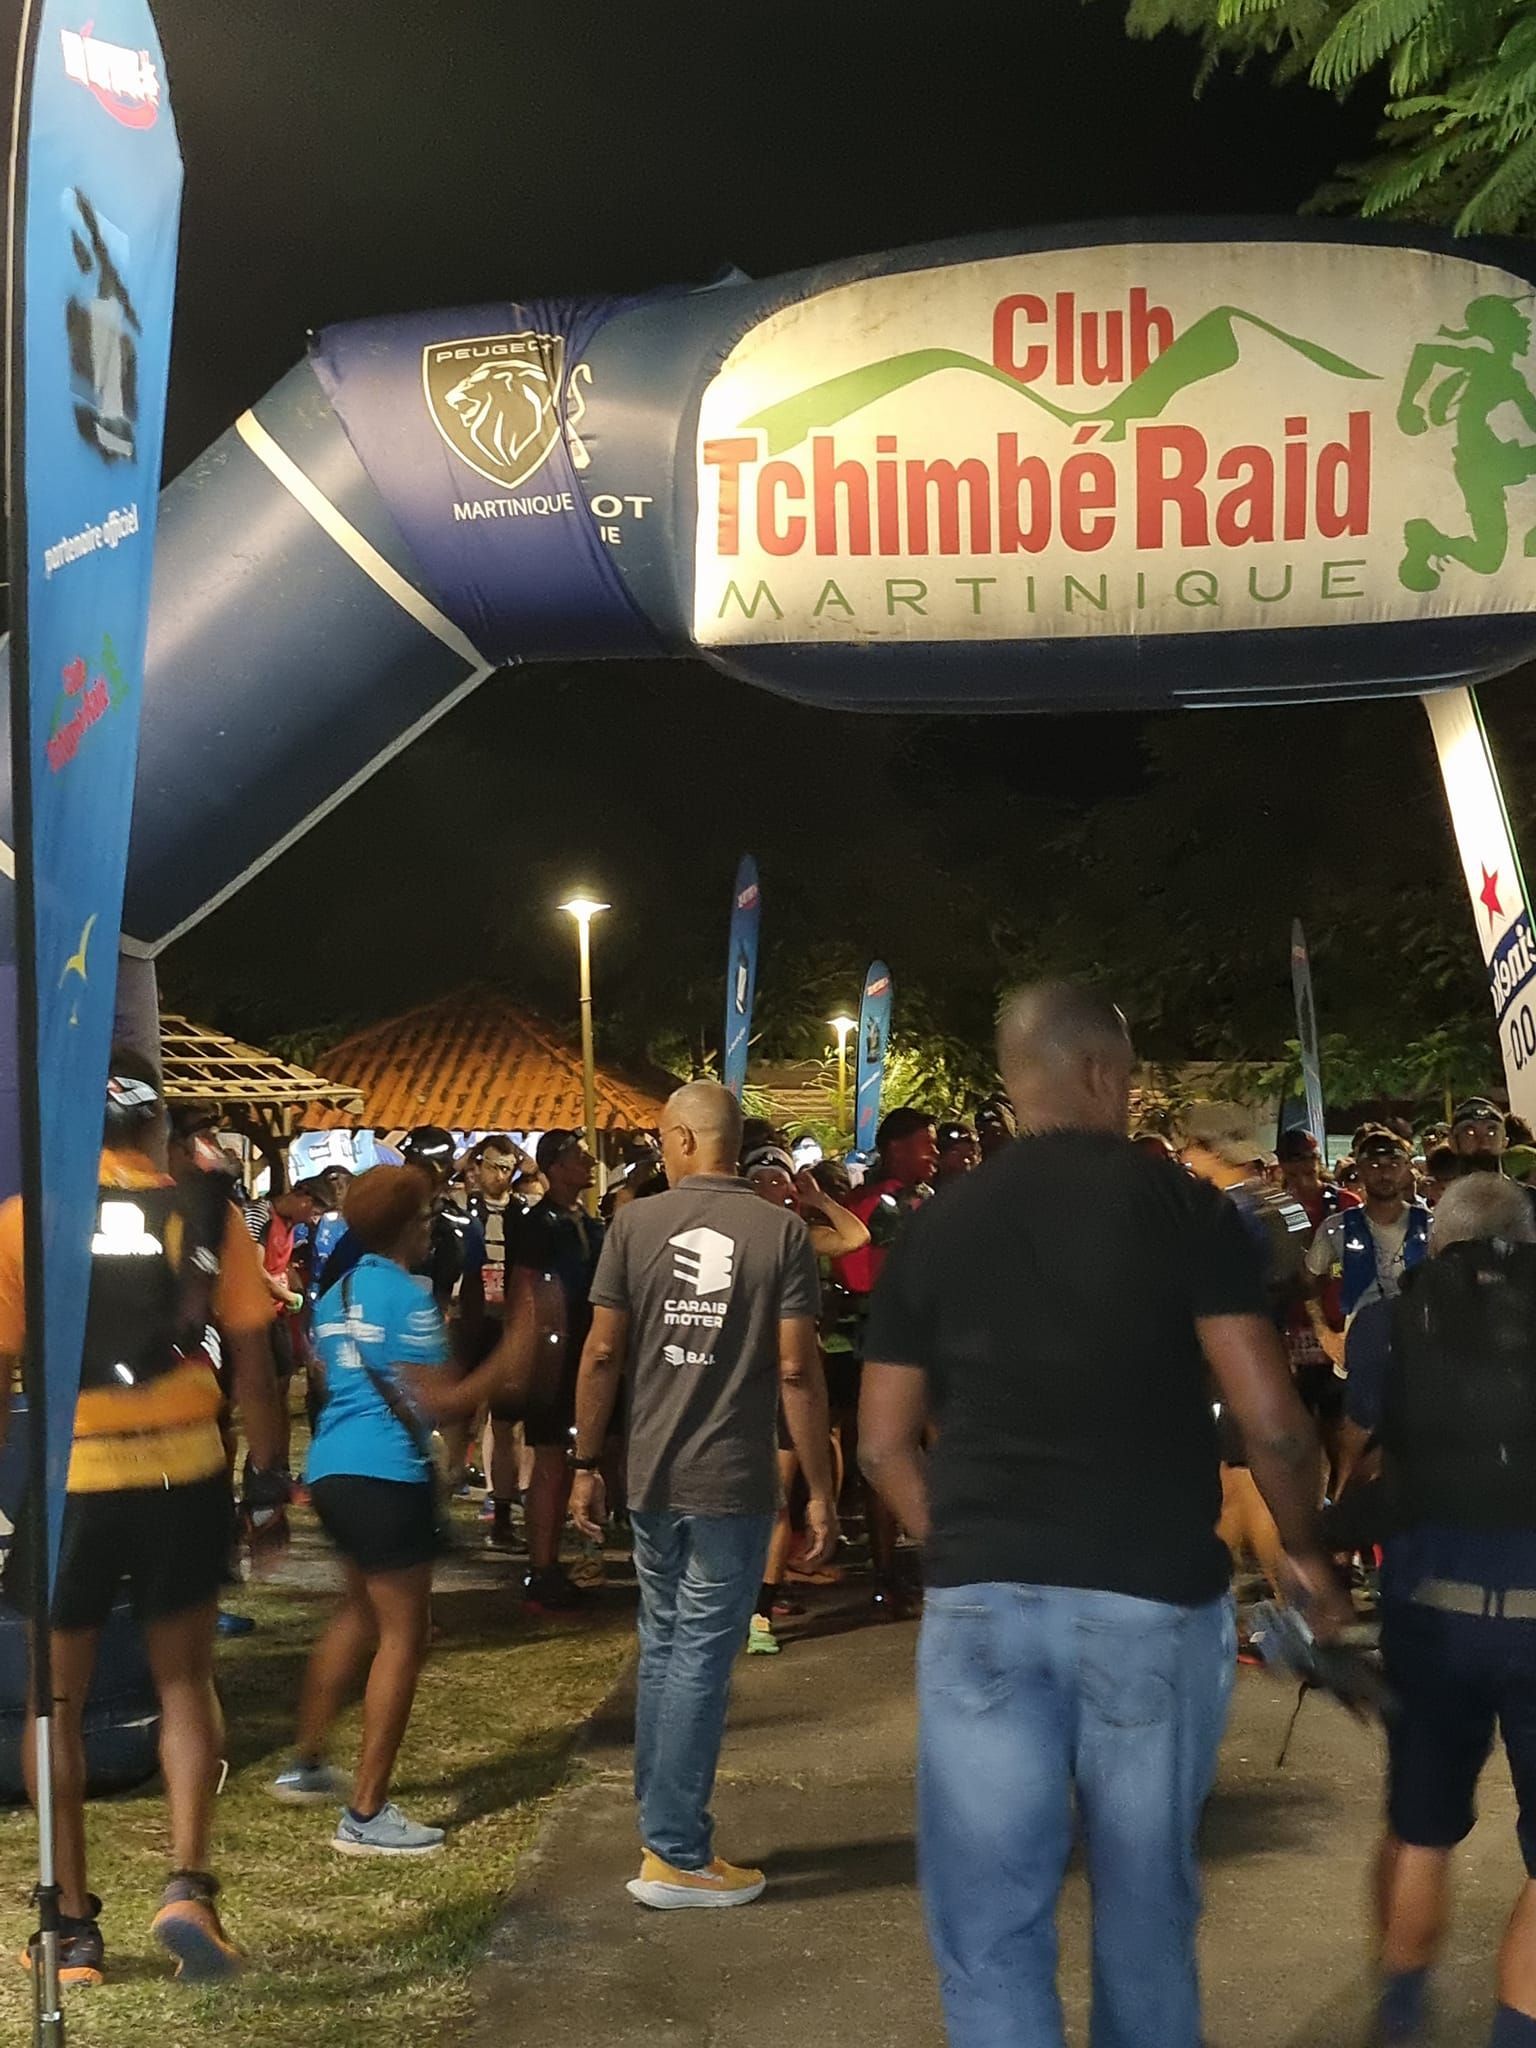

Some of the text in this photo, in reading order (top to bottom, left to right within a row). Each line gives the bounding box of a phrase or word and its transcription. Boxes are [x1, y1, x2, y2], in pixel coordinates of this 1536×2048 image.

[993, 287, 1174, 385] Club
[703, 411, 1371, 558] Tchimbé Raid
[453, 493, 575, 520] MARTINIQUE
[718, 560, 1367, 619] MARTINIQUE
[664, 1299, 728, 1315] CARAIB
[664, 1313, 723, 1328] MOTER
